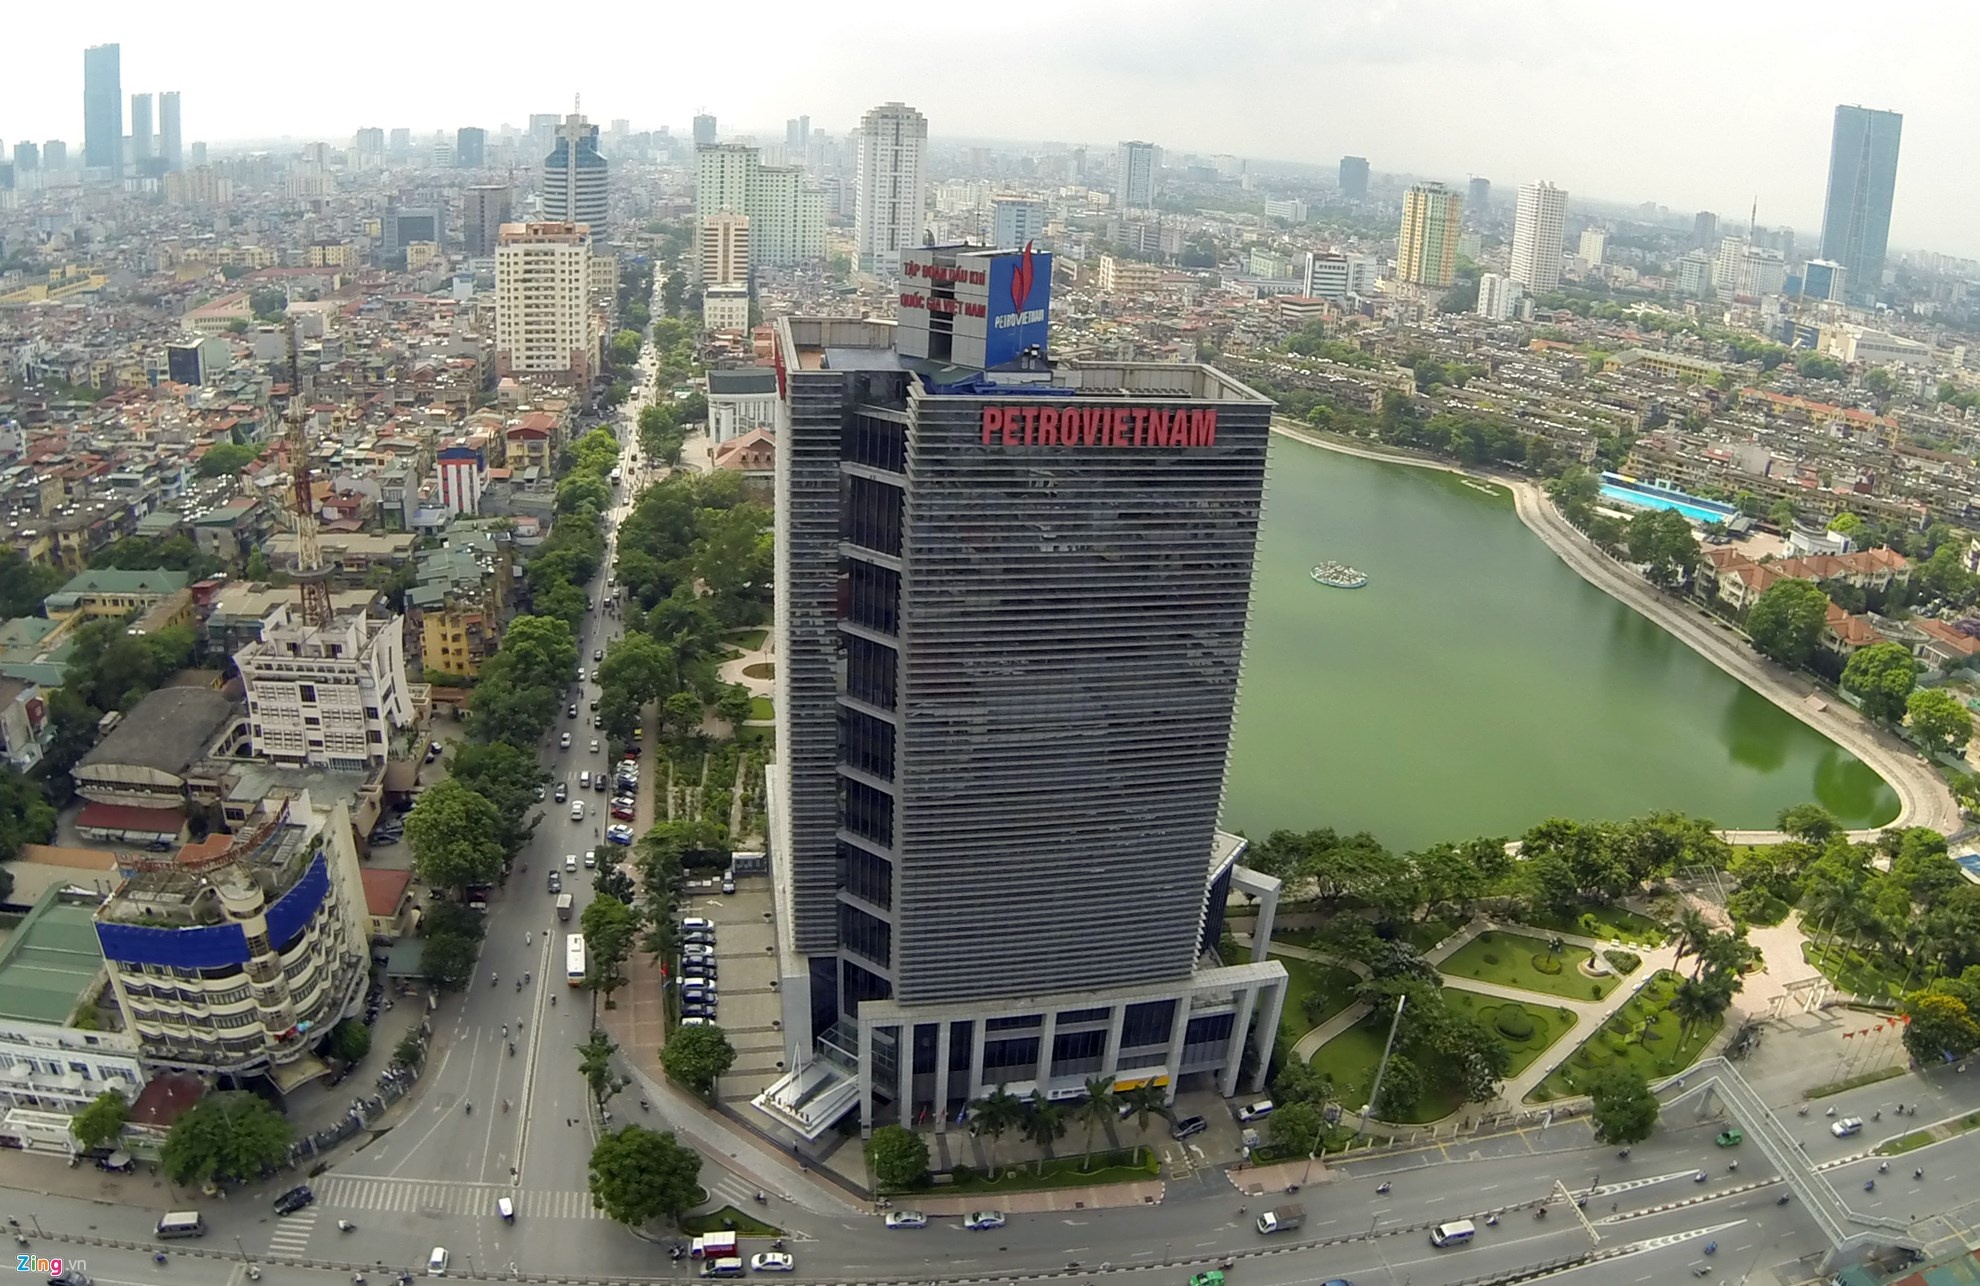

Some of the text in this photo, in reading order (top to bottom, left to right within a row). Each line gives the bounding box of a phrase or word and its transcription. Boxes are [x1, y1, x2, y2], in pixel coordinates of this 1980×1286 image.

[900, 290, 925, 310] QUỐC
[965, 302, 987, 318] NAM
[982, 406, 1217, 446] PETROVIETNAM
